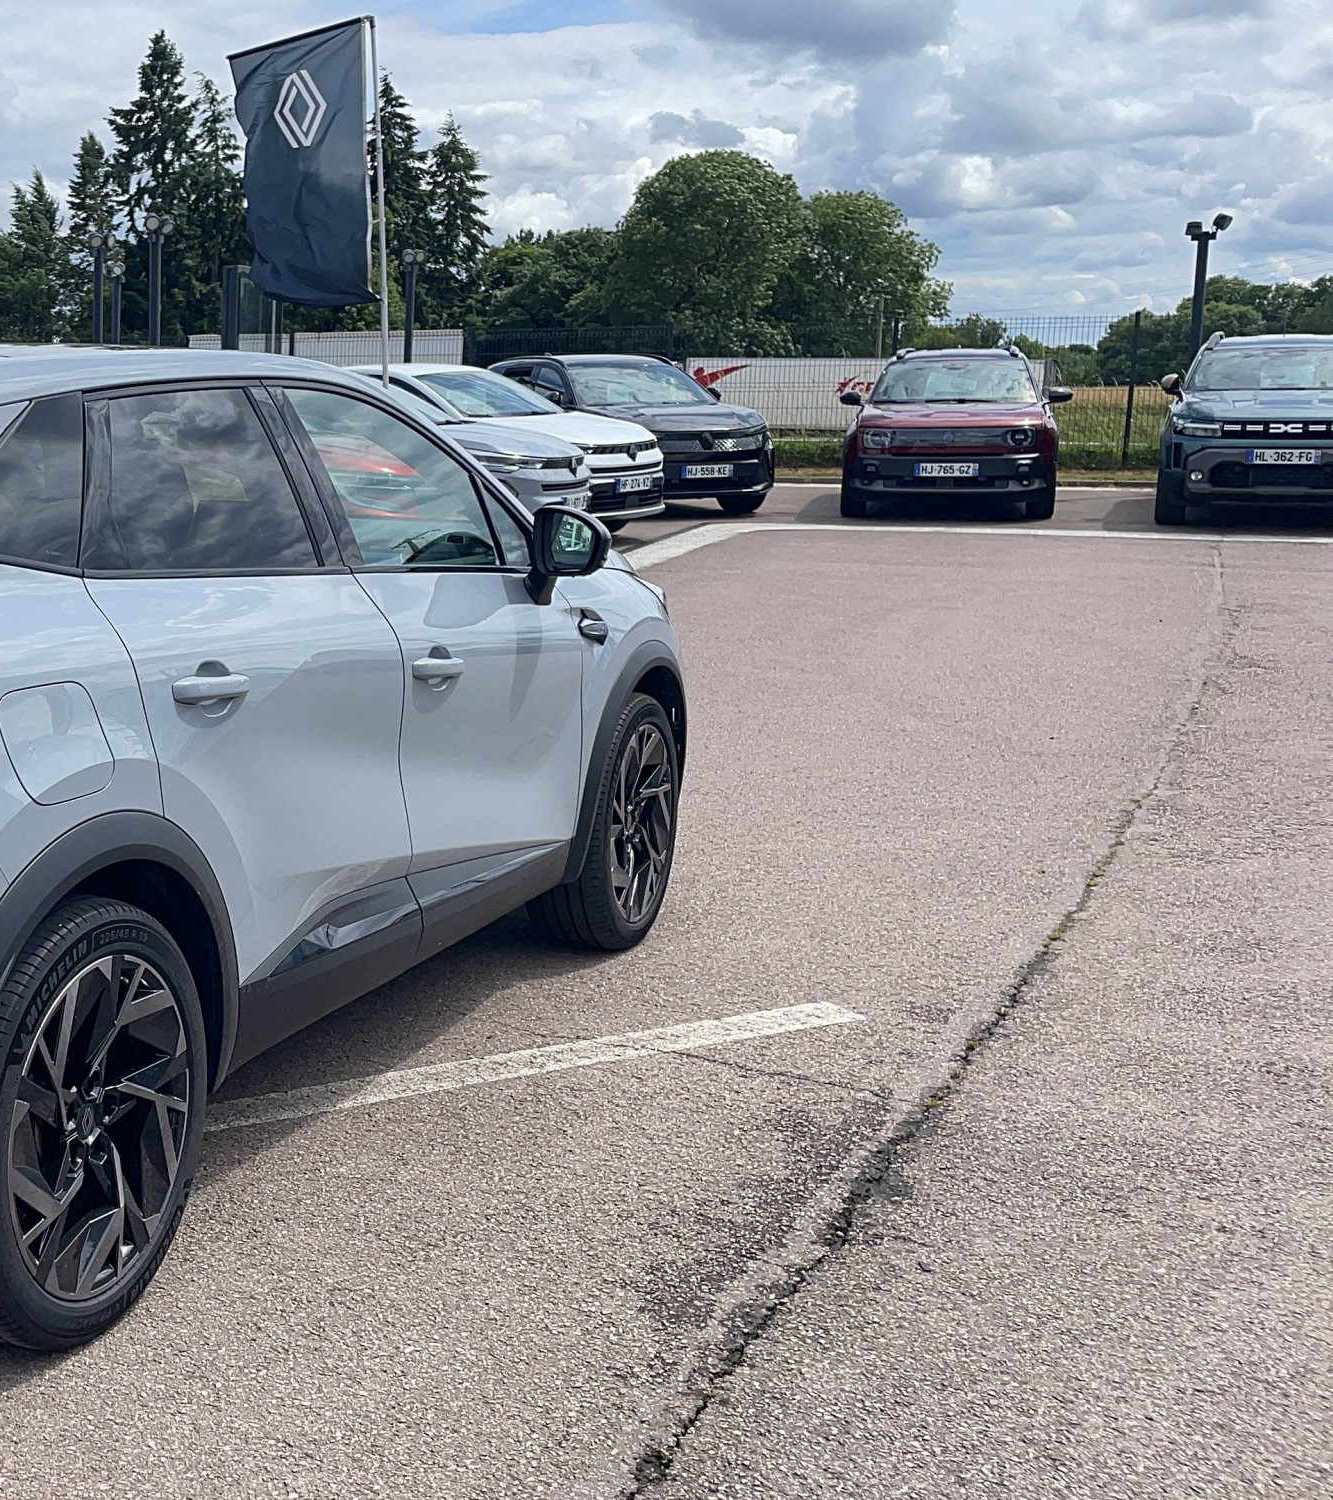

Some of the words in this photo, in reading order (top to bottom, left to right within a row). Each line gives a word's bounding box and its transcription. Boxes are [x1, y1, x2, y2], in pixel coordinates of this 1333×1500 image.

[1254, 451, 1313, 462] HL-362-FG
[687, 465, 728, 477] HJ-558-KE
[921, 464, 971, 475] HJ-765-GZ
[25, 939, 88, 1031] MICHELIN
